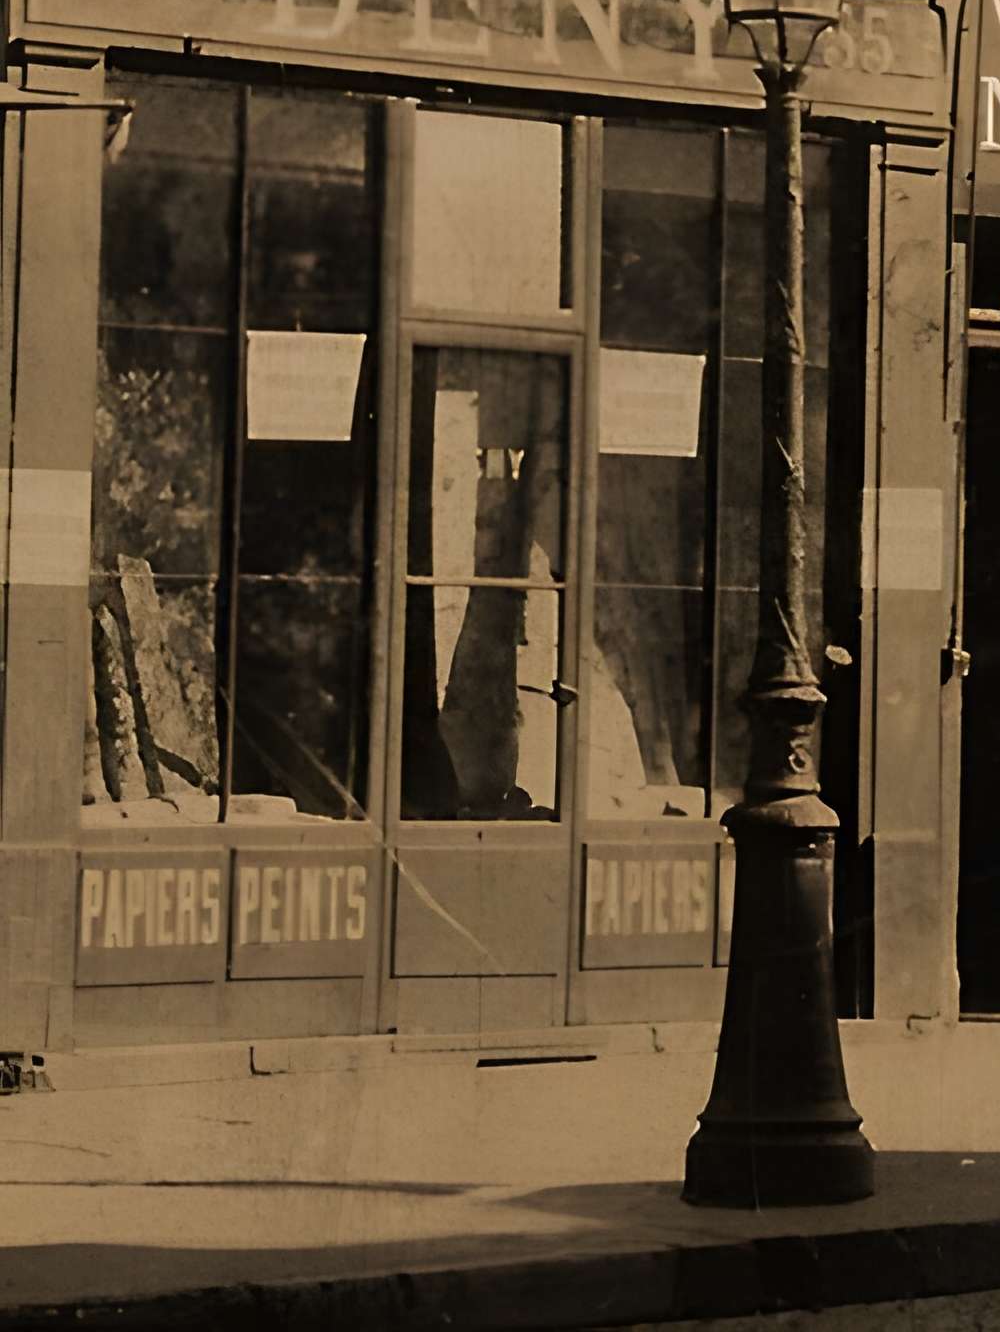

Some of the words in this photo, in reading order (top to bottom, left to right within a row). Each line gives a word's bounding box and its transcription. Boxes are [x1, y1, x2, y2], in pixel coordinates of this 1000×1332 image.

[80, 867, 223, 950] PAPIERS
[238, 864, 367, 945] PEINTS
[585, 857, 708, 937] PAPIERS
